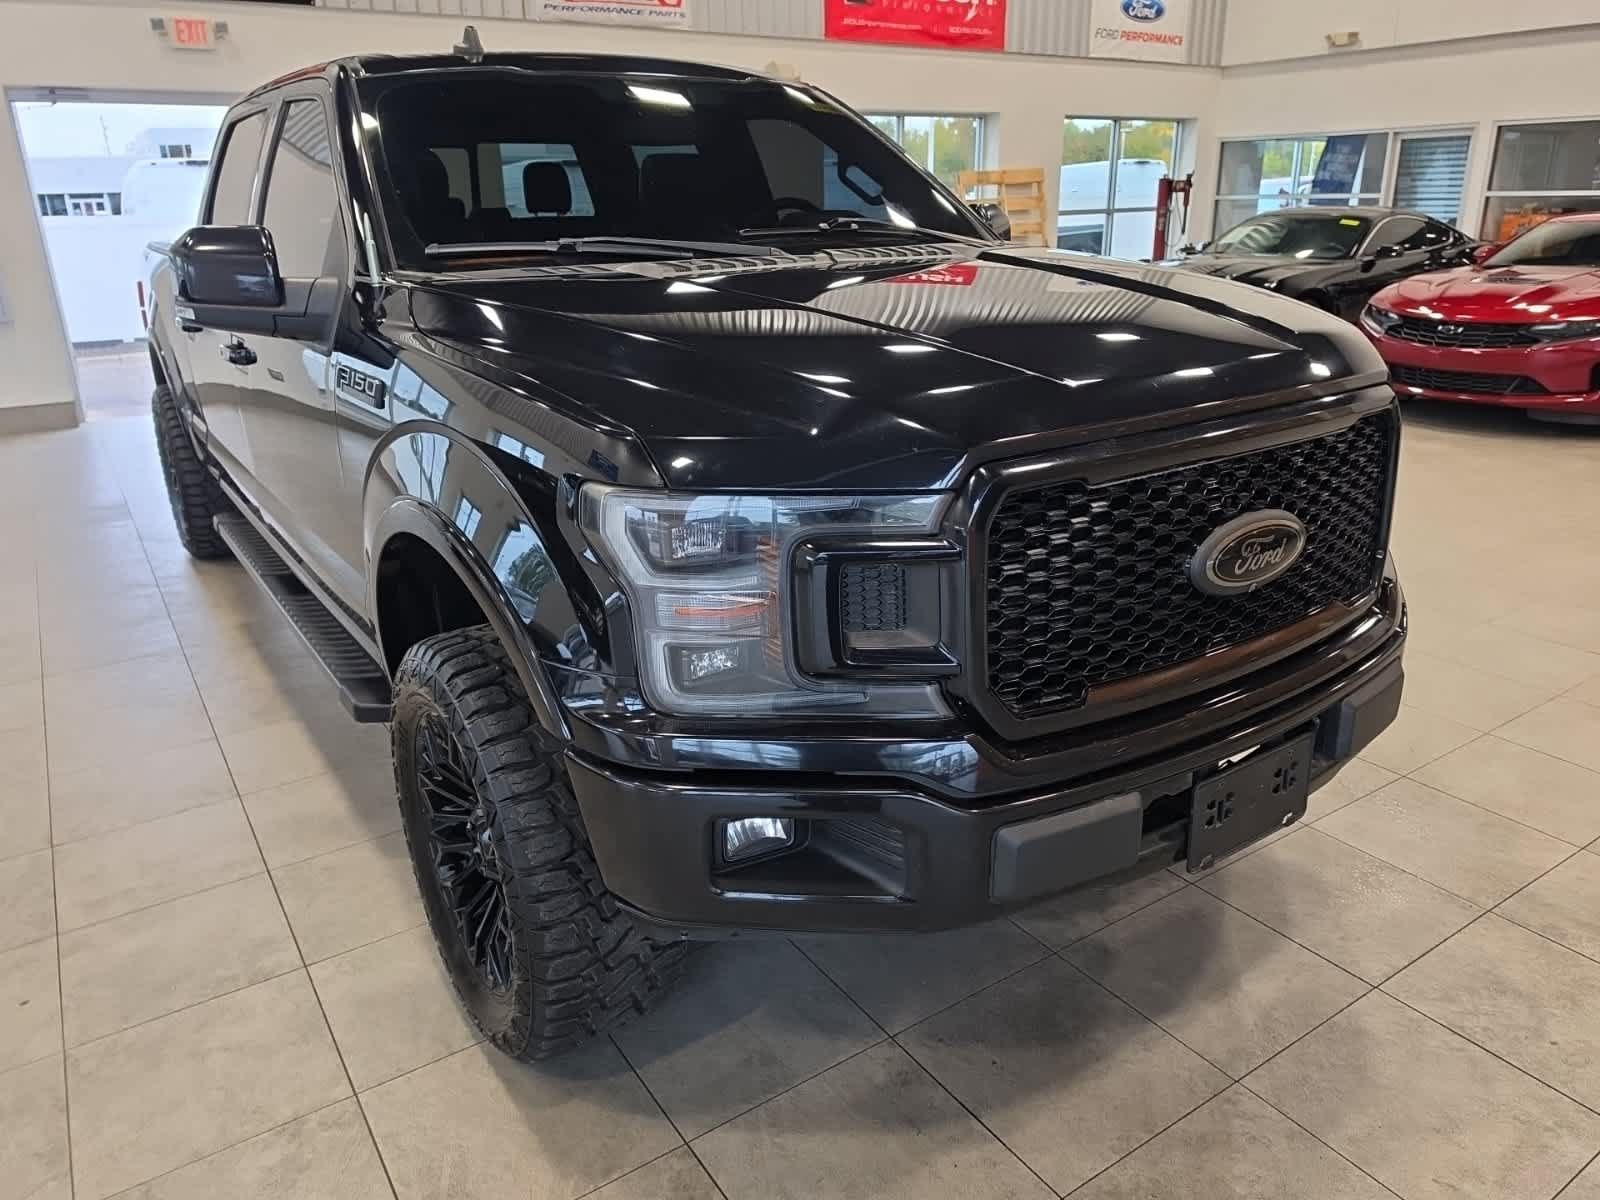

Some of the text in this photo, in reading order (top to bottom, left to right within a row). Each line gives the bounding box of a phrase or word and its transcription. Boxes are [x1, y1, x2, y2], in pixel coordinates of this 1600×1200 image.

[543, 3, 645, 17] PERFORMANCE
[648, 9, 687, 19] PARTS
[1128, 0, 1159, 18] Ford
[175, 19, 208, 44] EXIT
[1094, 26, 1184, 47] FORD PERFORMANCE
[1234, 534, 1288, 575] Ford
